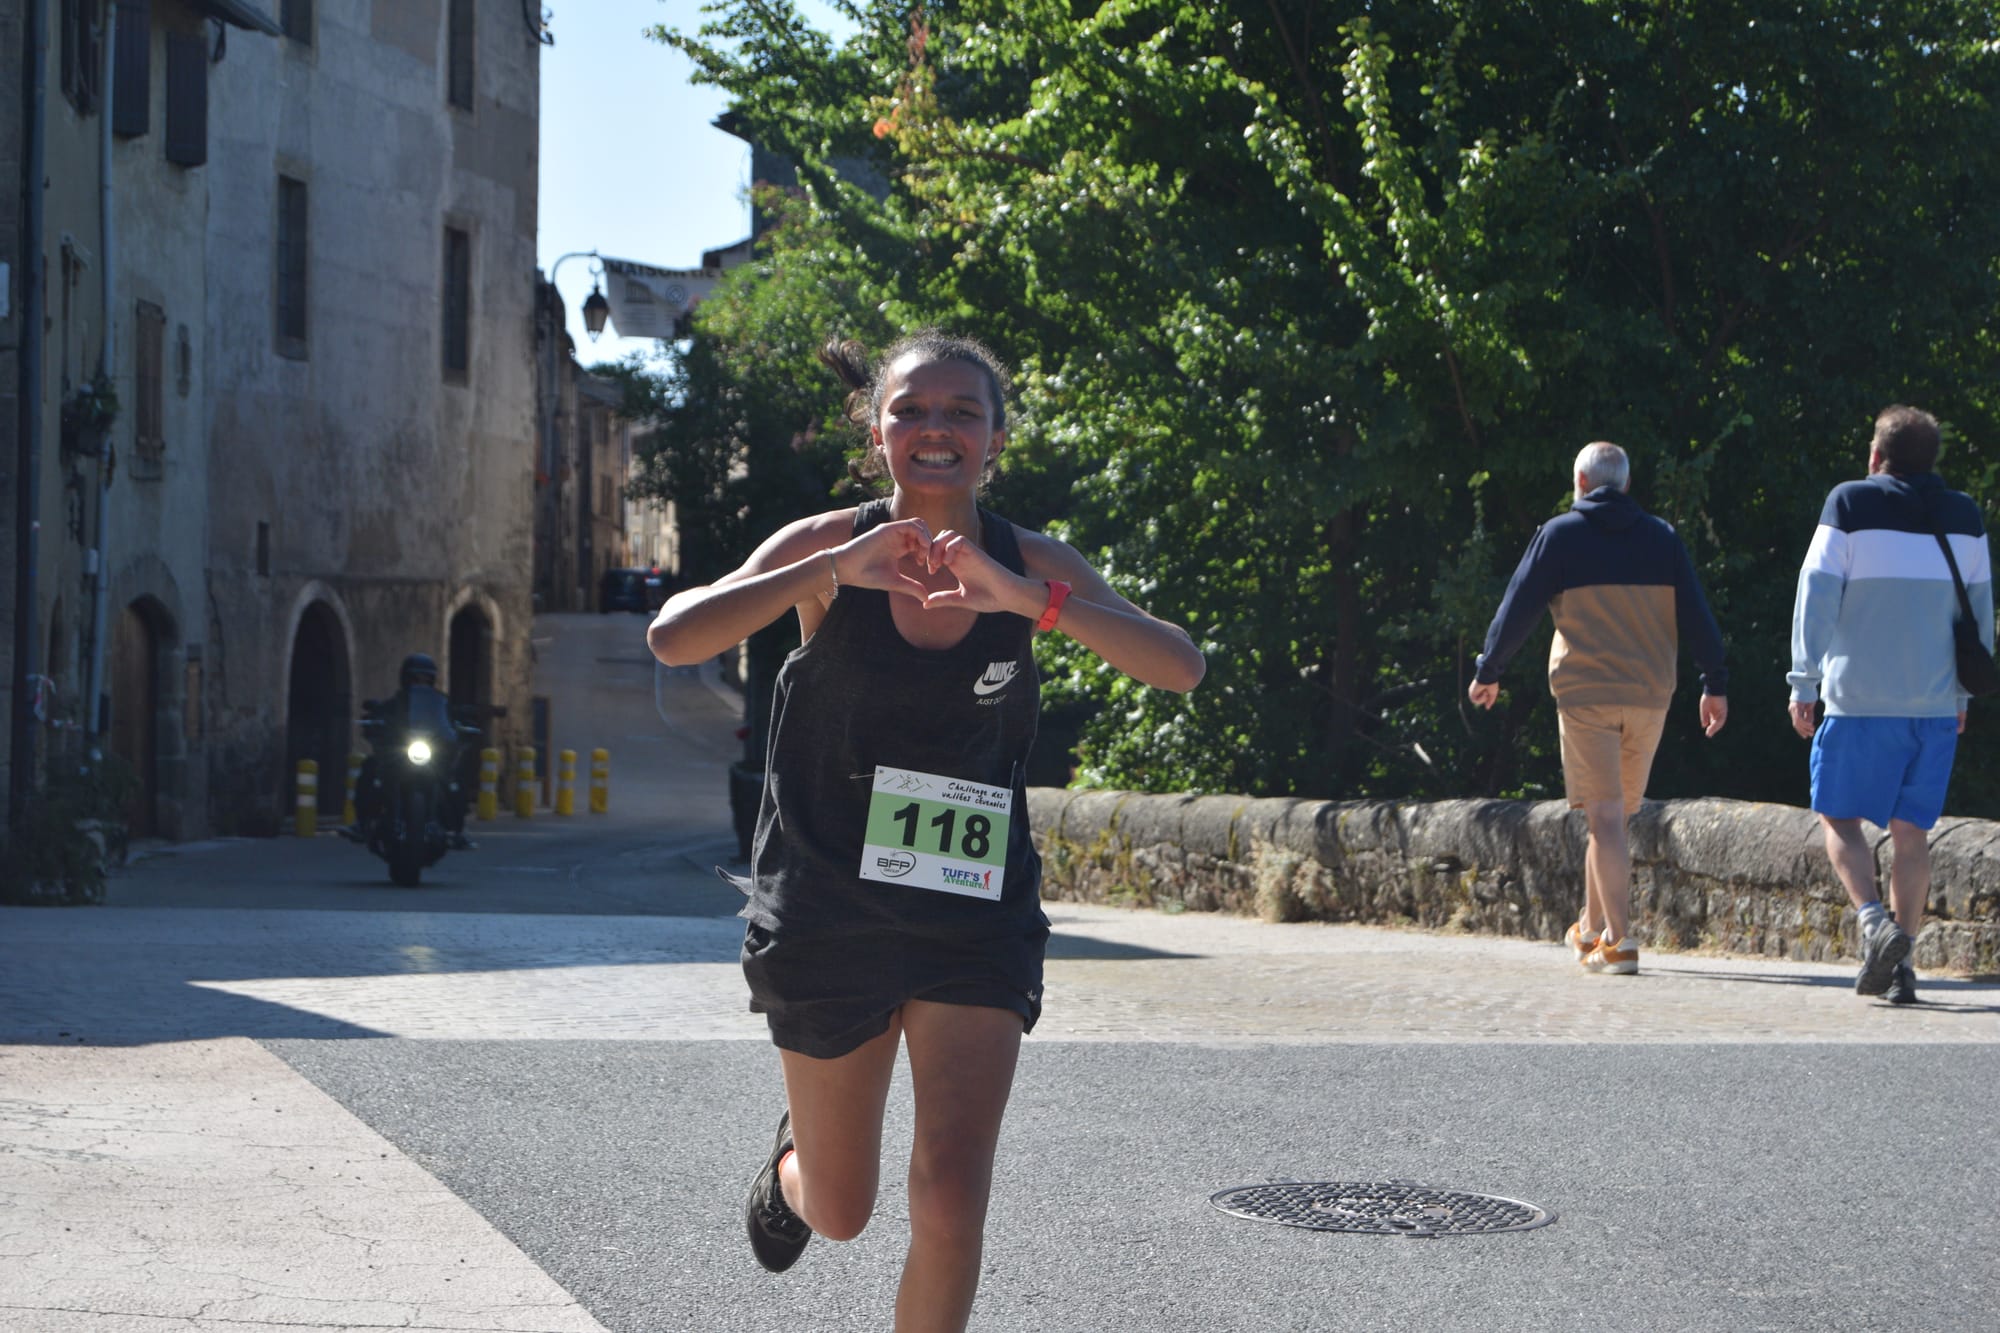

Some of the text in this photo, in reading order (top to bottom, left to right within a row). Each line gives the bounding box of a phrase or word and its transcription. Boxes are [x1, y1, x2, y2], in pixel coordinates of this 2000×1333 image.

[983, 660, 1017, 681] NIKE
[942, 791, 1006, 809] vallées cévenoles
[947, 782, 1004, 800] Challenge des
[893, 801, 991, 859] 118
[877, 857, 911, 870] BFP
[941, 866, 980, 882] TUFF'S
